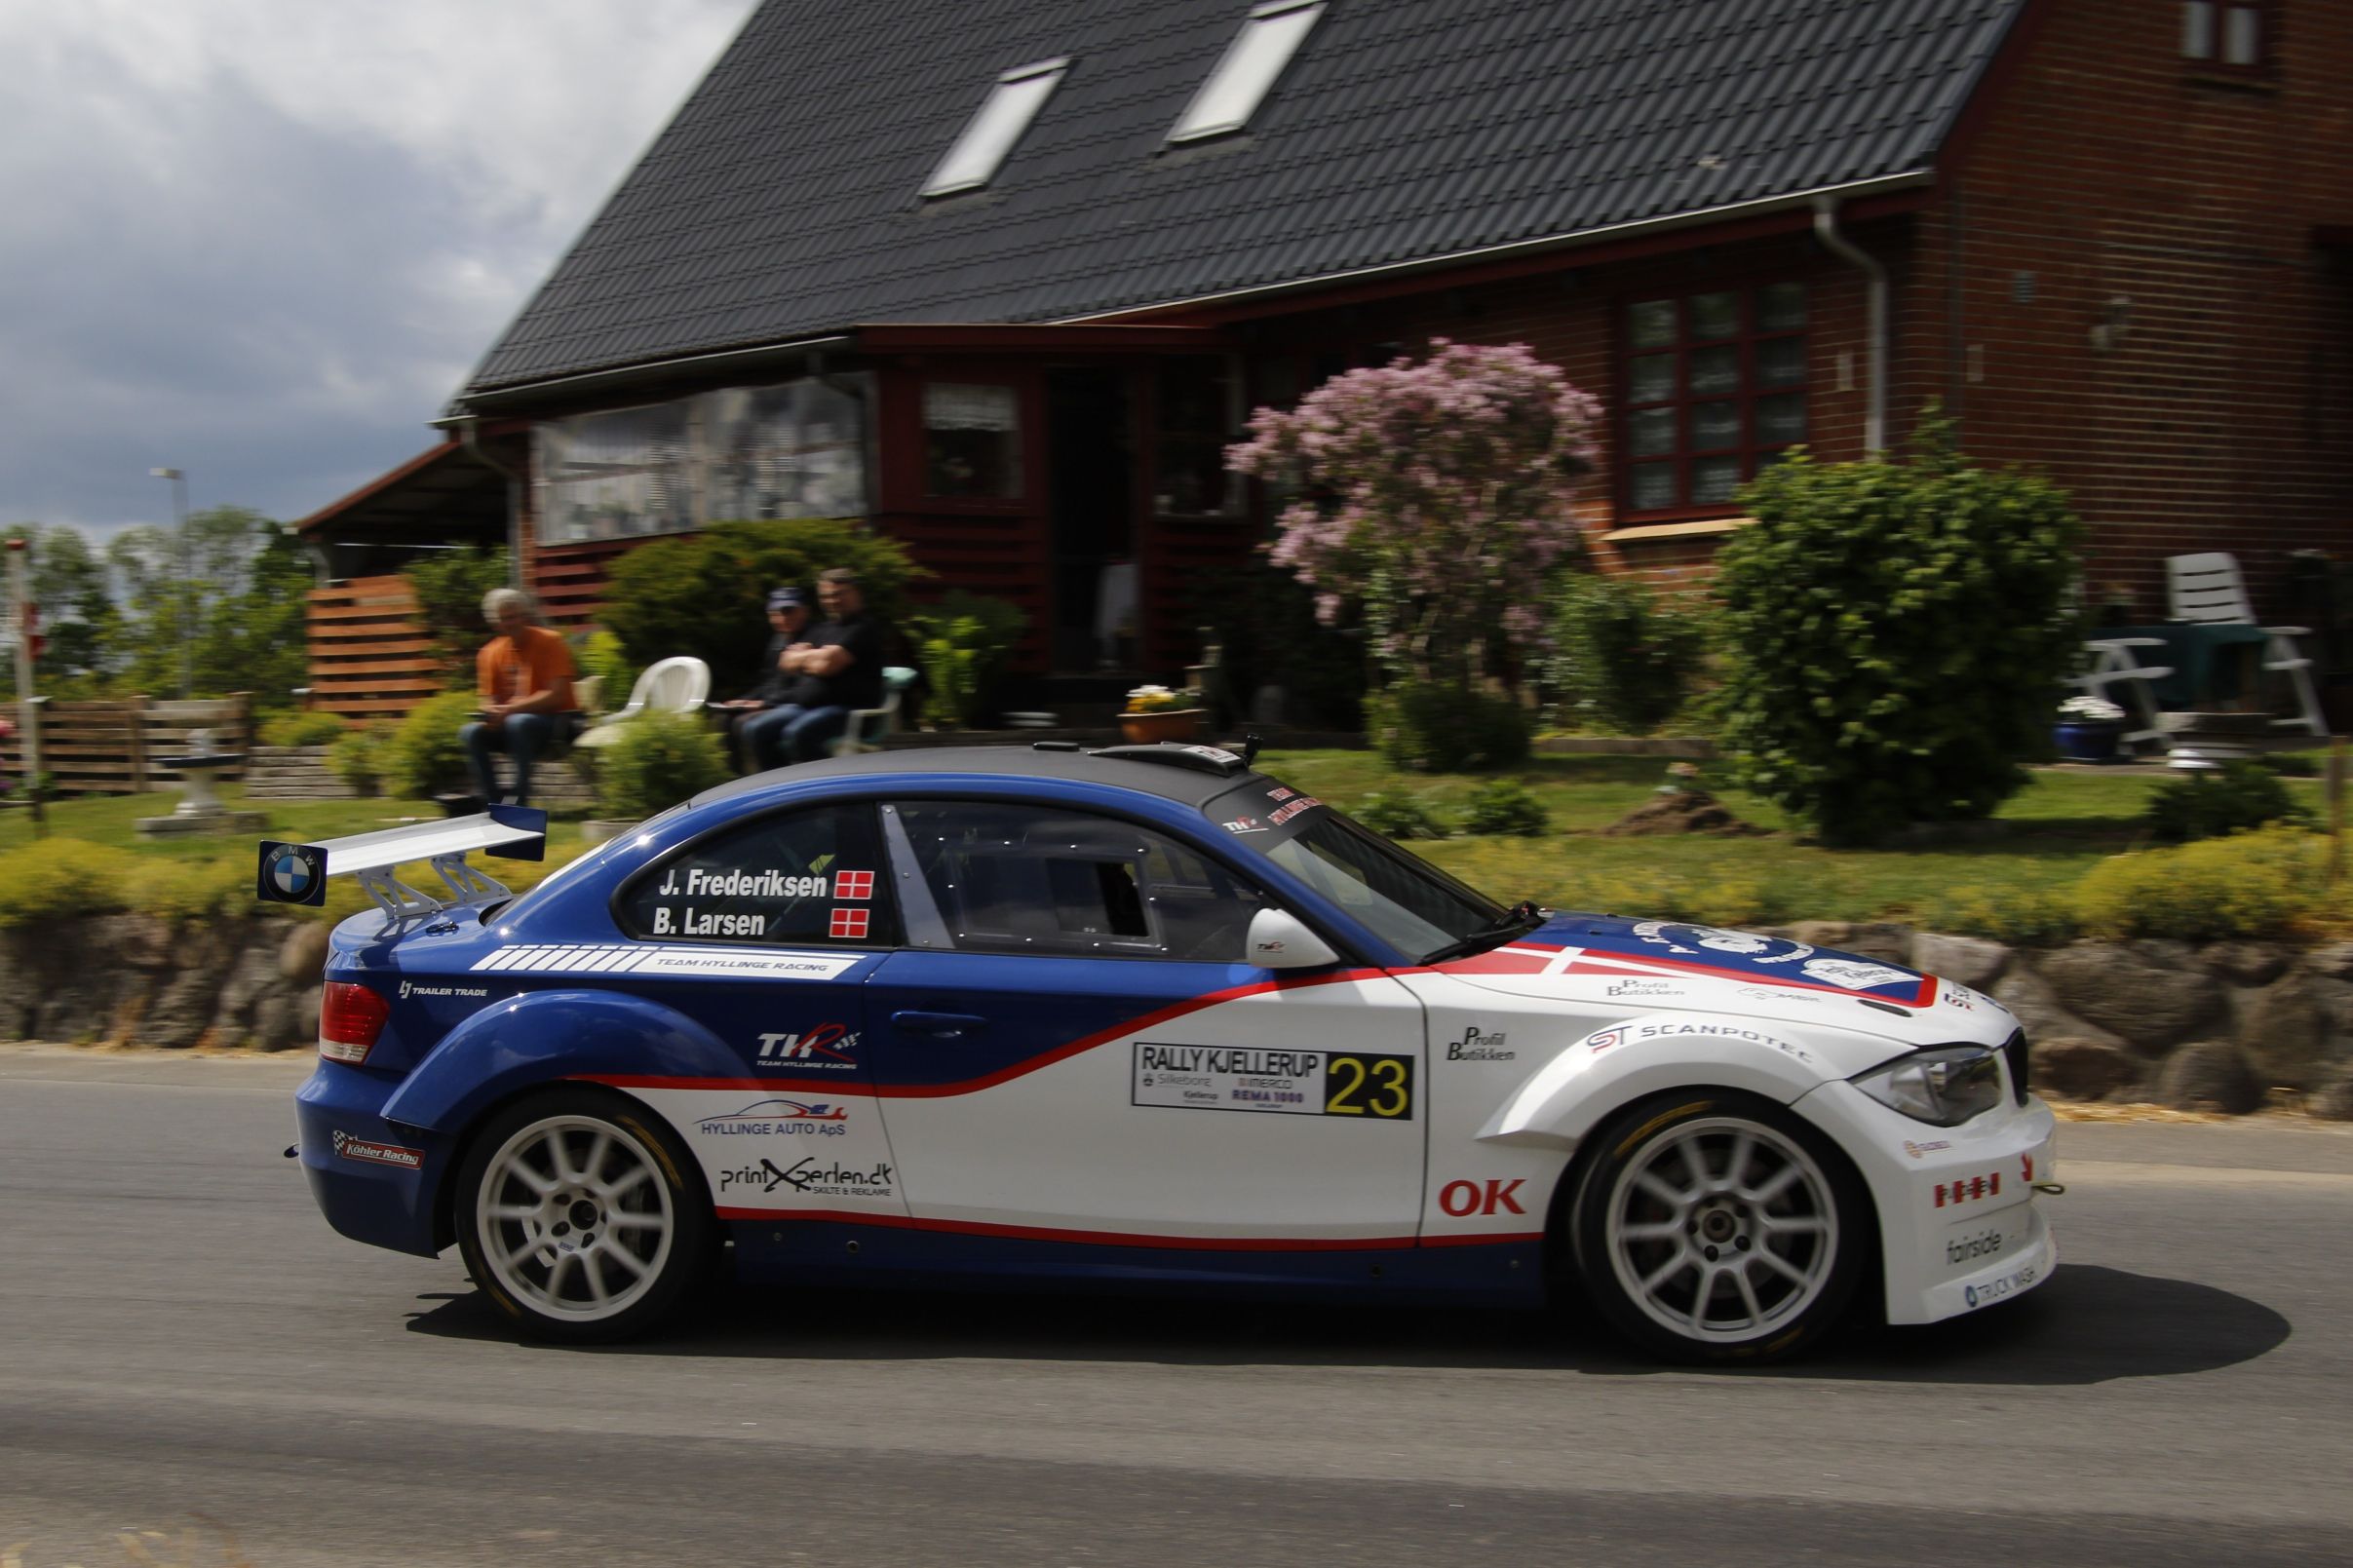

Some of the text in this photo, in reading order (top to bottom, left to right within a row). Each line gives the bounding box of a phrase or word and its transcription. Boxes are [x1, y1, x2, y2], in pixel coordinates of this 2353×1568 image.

[270, 845, 317, 867] BMW
[659, 868, 828, 898] J. Frederiksen
[653, 907, 765, 936] B. Larsen
[657, 958, 829, 973] TEAM HYLLINGE RACING
[1464, 1026, 1506, 1046] Profil
[1141, 1046, 1319, 1078] RALLY KJELLERUP
[1447, 1042, 1516, 1060] Butikken
[1231, 1090, 1304, 1103] REMA 1000
[1325, 1056, 1408, 1117] 23
[701, 1123, 846, 1137] HYLLINGE AUTO ApS
[346, 1143, 419, 1166] Köhler Racing
[813, 1186, 842, 1195] SKILTE
[1439, 1178, 1527, 1217] OK
